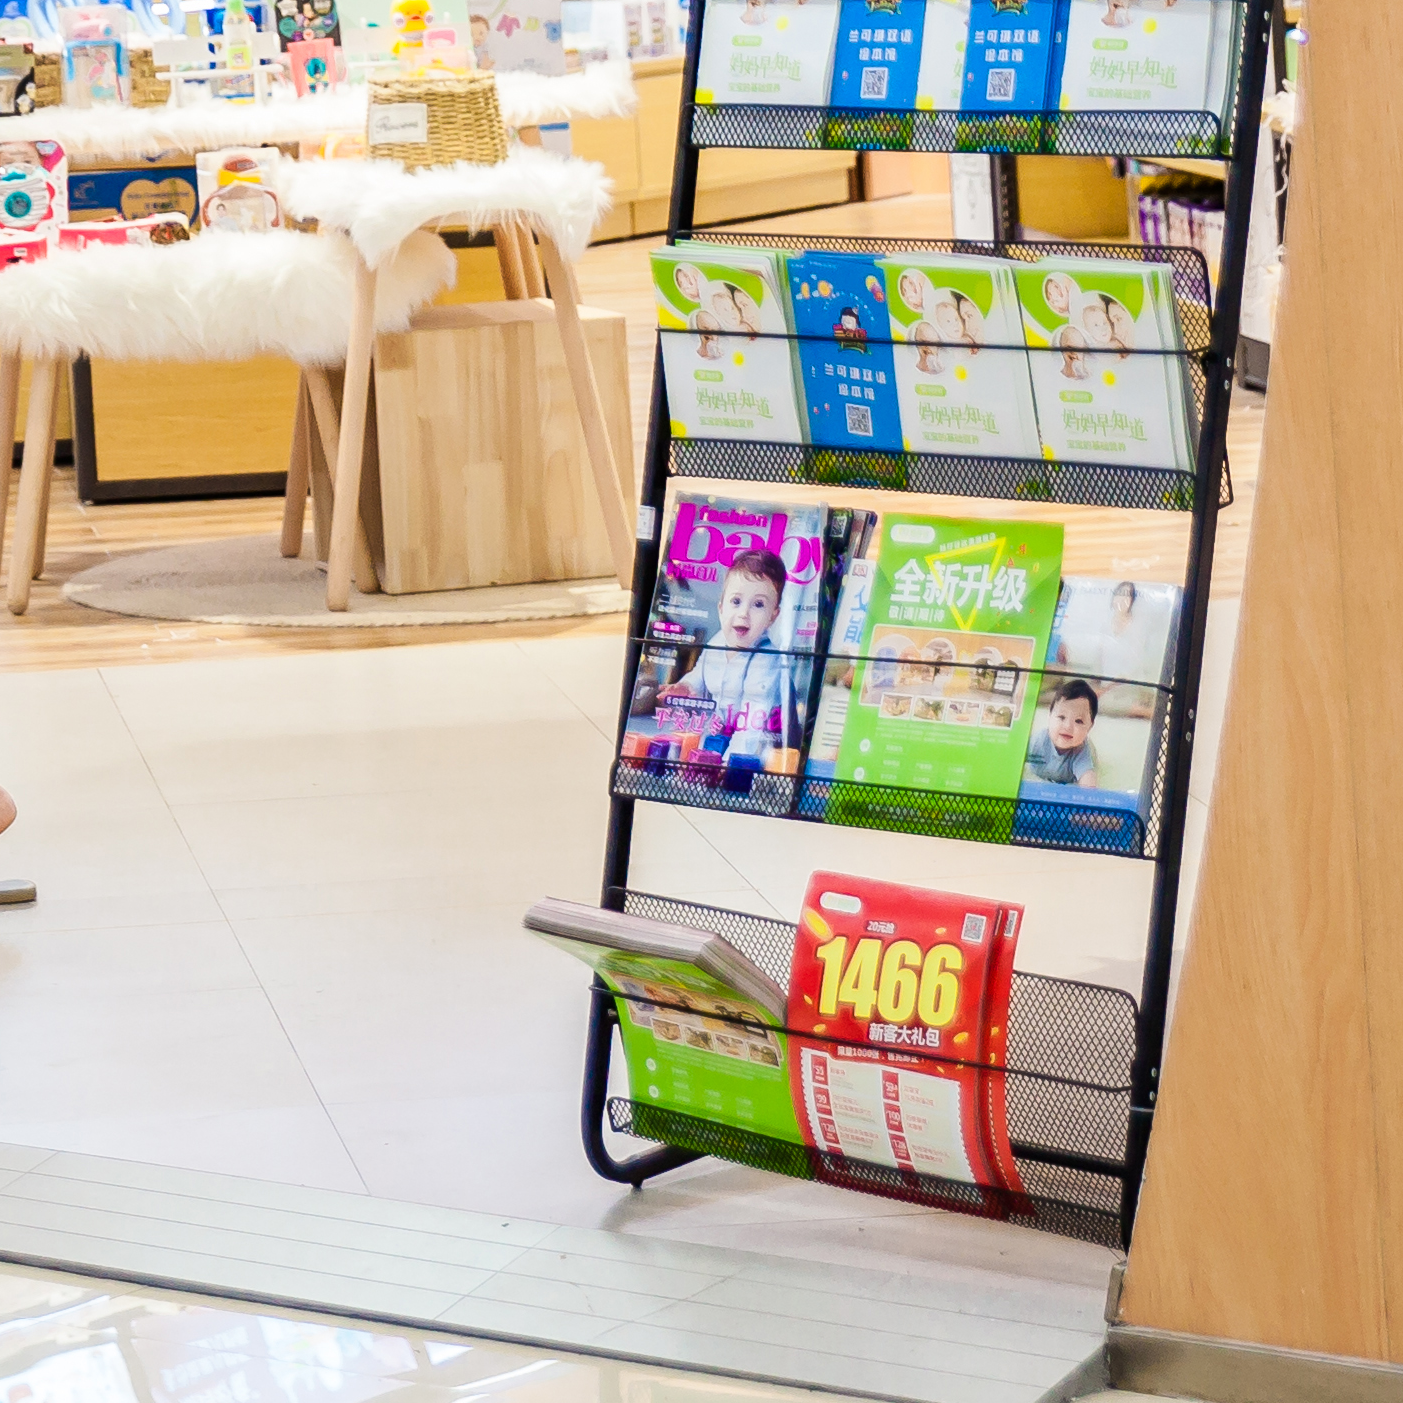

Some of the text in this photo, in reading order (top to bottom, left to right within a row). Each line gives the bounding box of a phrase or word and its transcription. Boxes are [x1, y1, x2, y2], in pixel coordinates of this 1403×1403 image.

[729, 51, 802, 82] 妈妈早知道
[1089, 55, 1178, 89] 妈妈早知道
[695, 385, 774, 420] 妈妈早知道
[918, 400, 1000, 435] 妈妈早知道
[1061, 407, 1148, 442] 妈妈早知道
[699, 504, 769, 528] fashion
[889, 557, 1027, 613] 全新升级
[816, 935, 964, 1027] 1466
[868, 1022, 941, 1047] 新客大礼包
